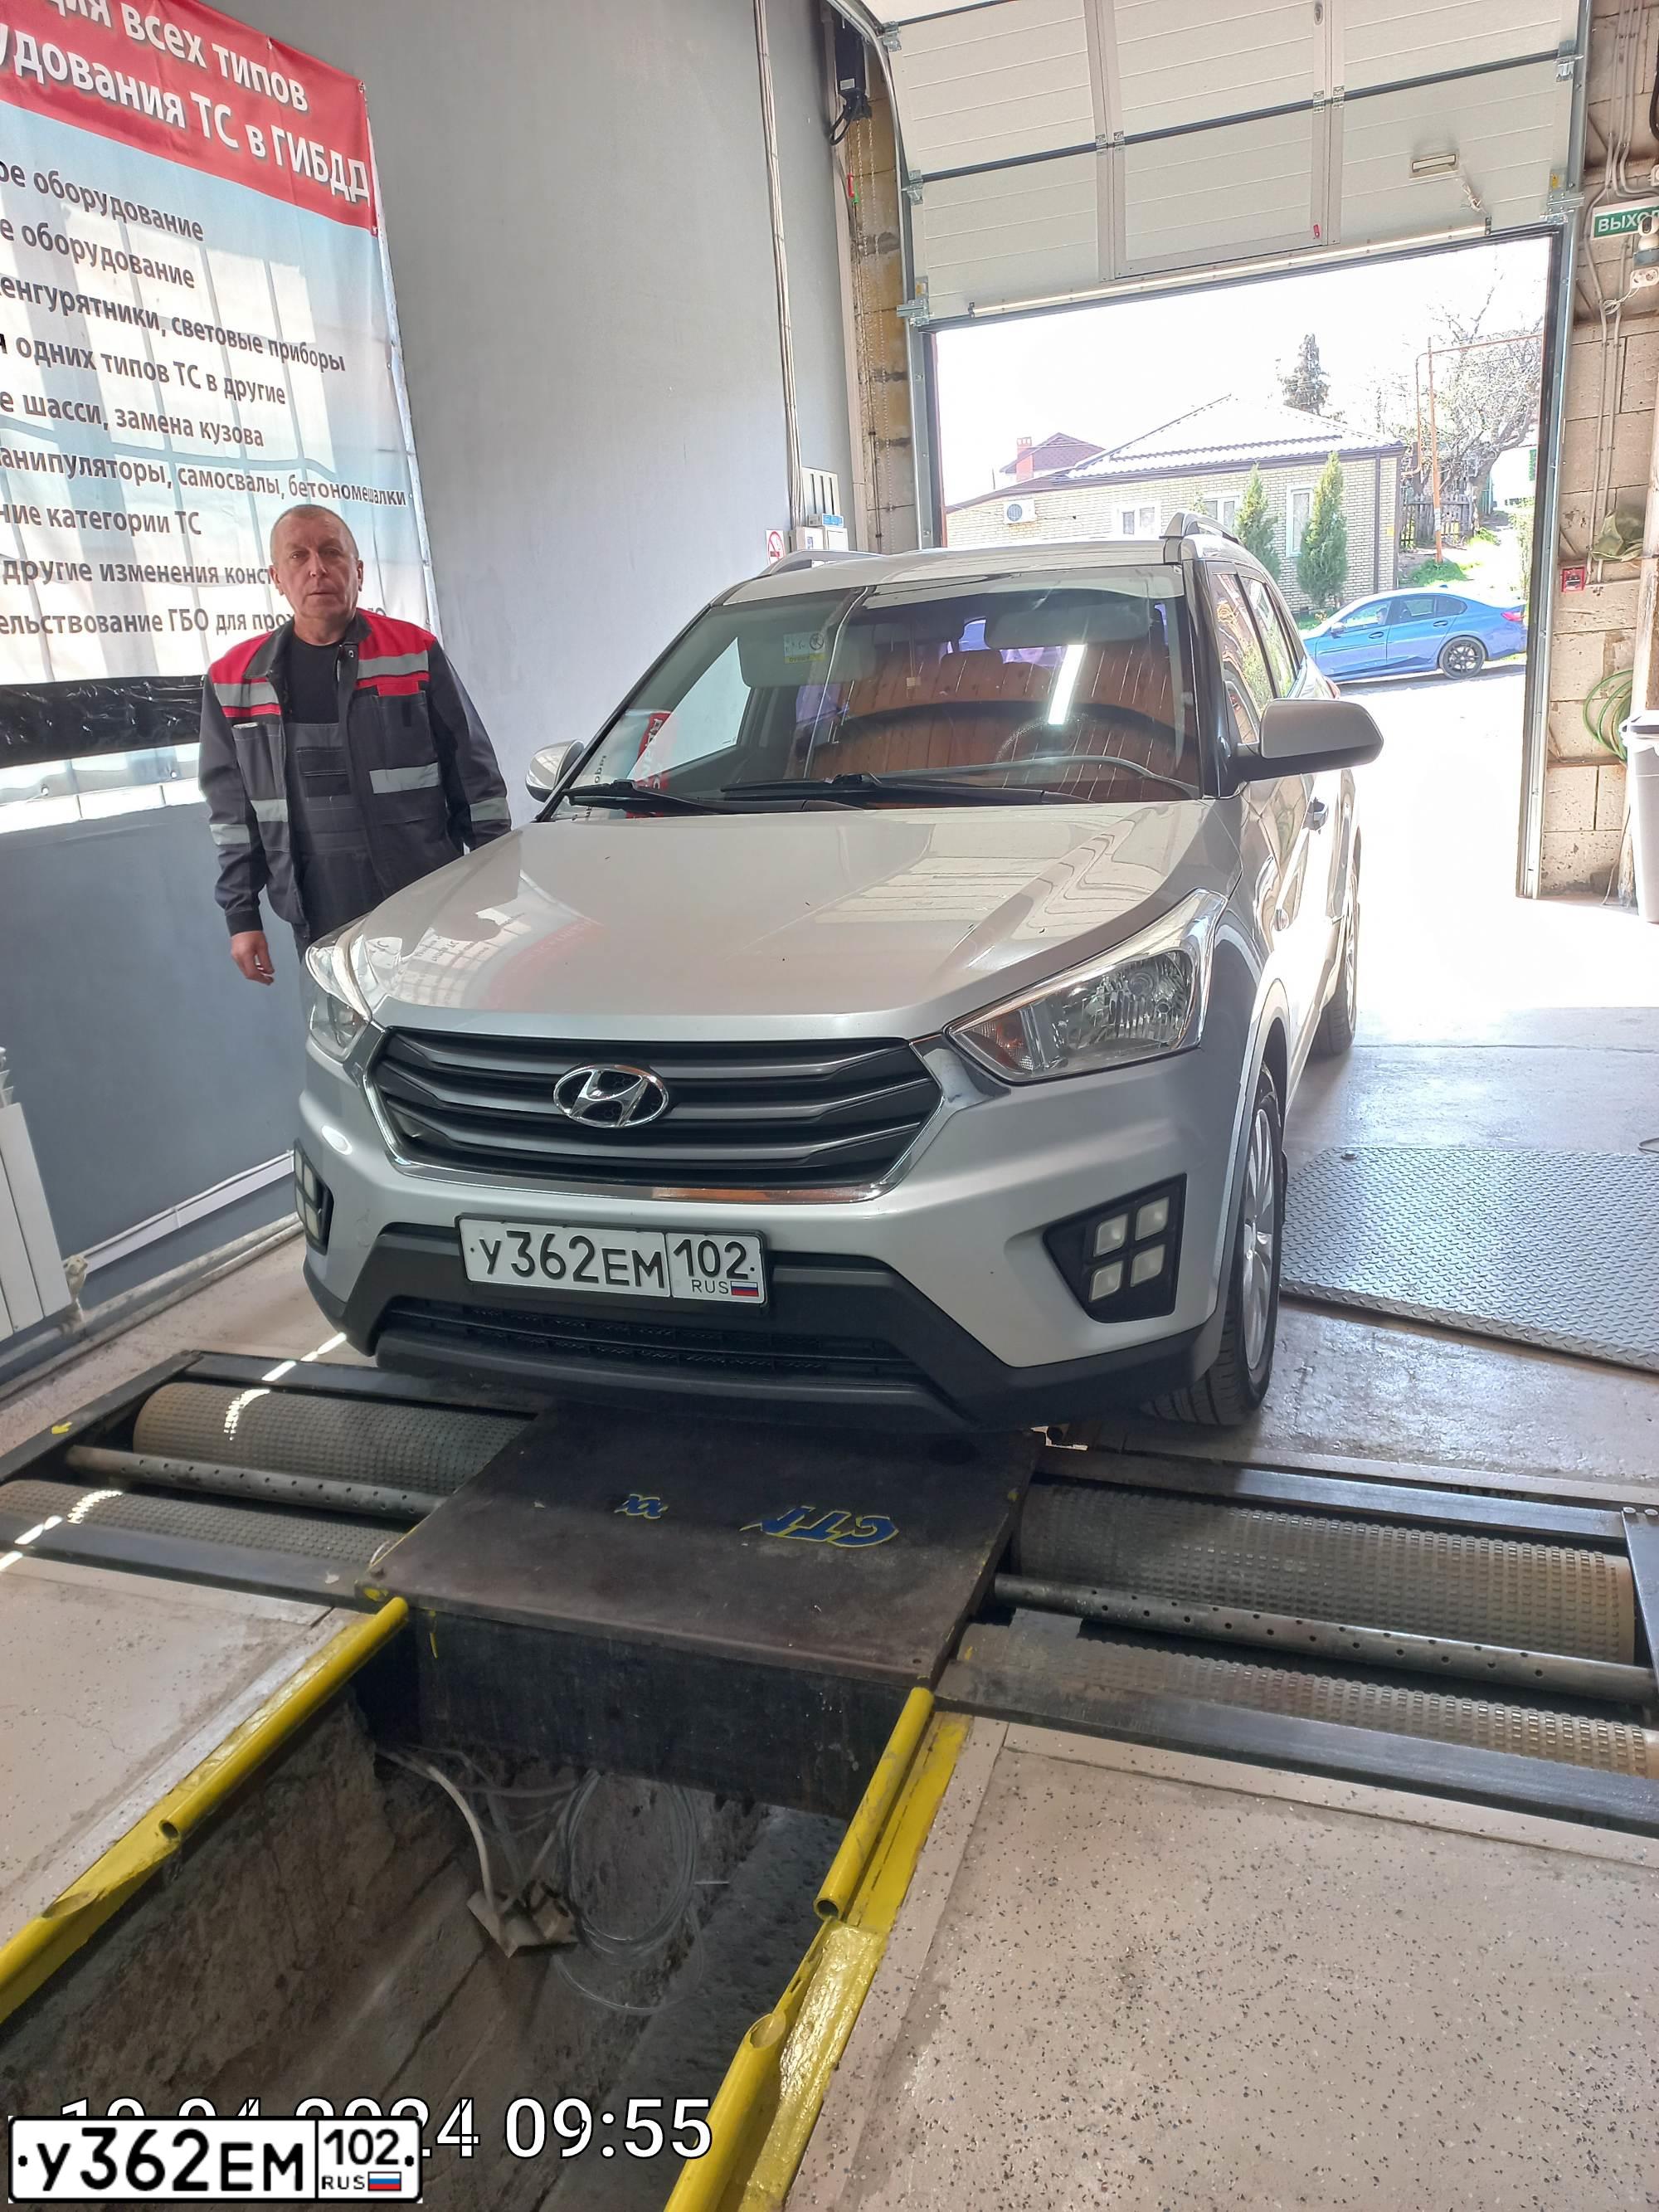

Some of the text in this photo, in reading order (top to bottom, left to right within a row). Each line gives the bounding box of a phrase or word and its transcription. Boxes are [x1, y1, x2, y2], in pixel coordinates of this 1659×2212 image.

[121, 2, 206, 68] всех
[212, 43, 308, 112] типов
[190, 92, 239, 149] ТС
[246, 124, 266, 158] в
[271, 124, 371, 207] ГИБДД
[33, 170, 204, 241] оборудование
[22, 222, 194, 289] оборудование
[0, 276, 346, 373] енгурятники, световые приборы
[16, 337, 96, 370] одних
[101, 353, 170, 383] типов
[173, 362, 202, 389] ТС
[207, 373, 217, 392] в
[224, 377, 285, 405] другие
[22, 394, 109, 431] шасси,
[115, 408, 193, 437] замена
[199, 420, 264, 446] кузова
[178, 465, 285, 499] самосвалы,
[289, 475, 406, 506] бетономешалки
[46, 508, 170, 534] категории
[174, 511, 202, 535] ТС
[3, 560, 93, 585] другие
[100, 563, 219, 584] изменения
[0, 608, 293, 636] ельствование ГБО для про
[479, 1230, 749, 1289] У362ЕМ 102
[692, 1279, 729, 1294] RUS
